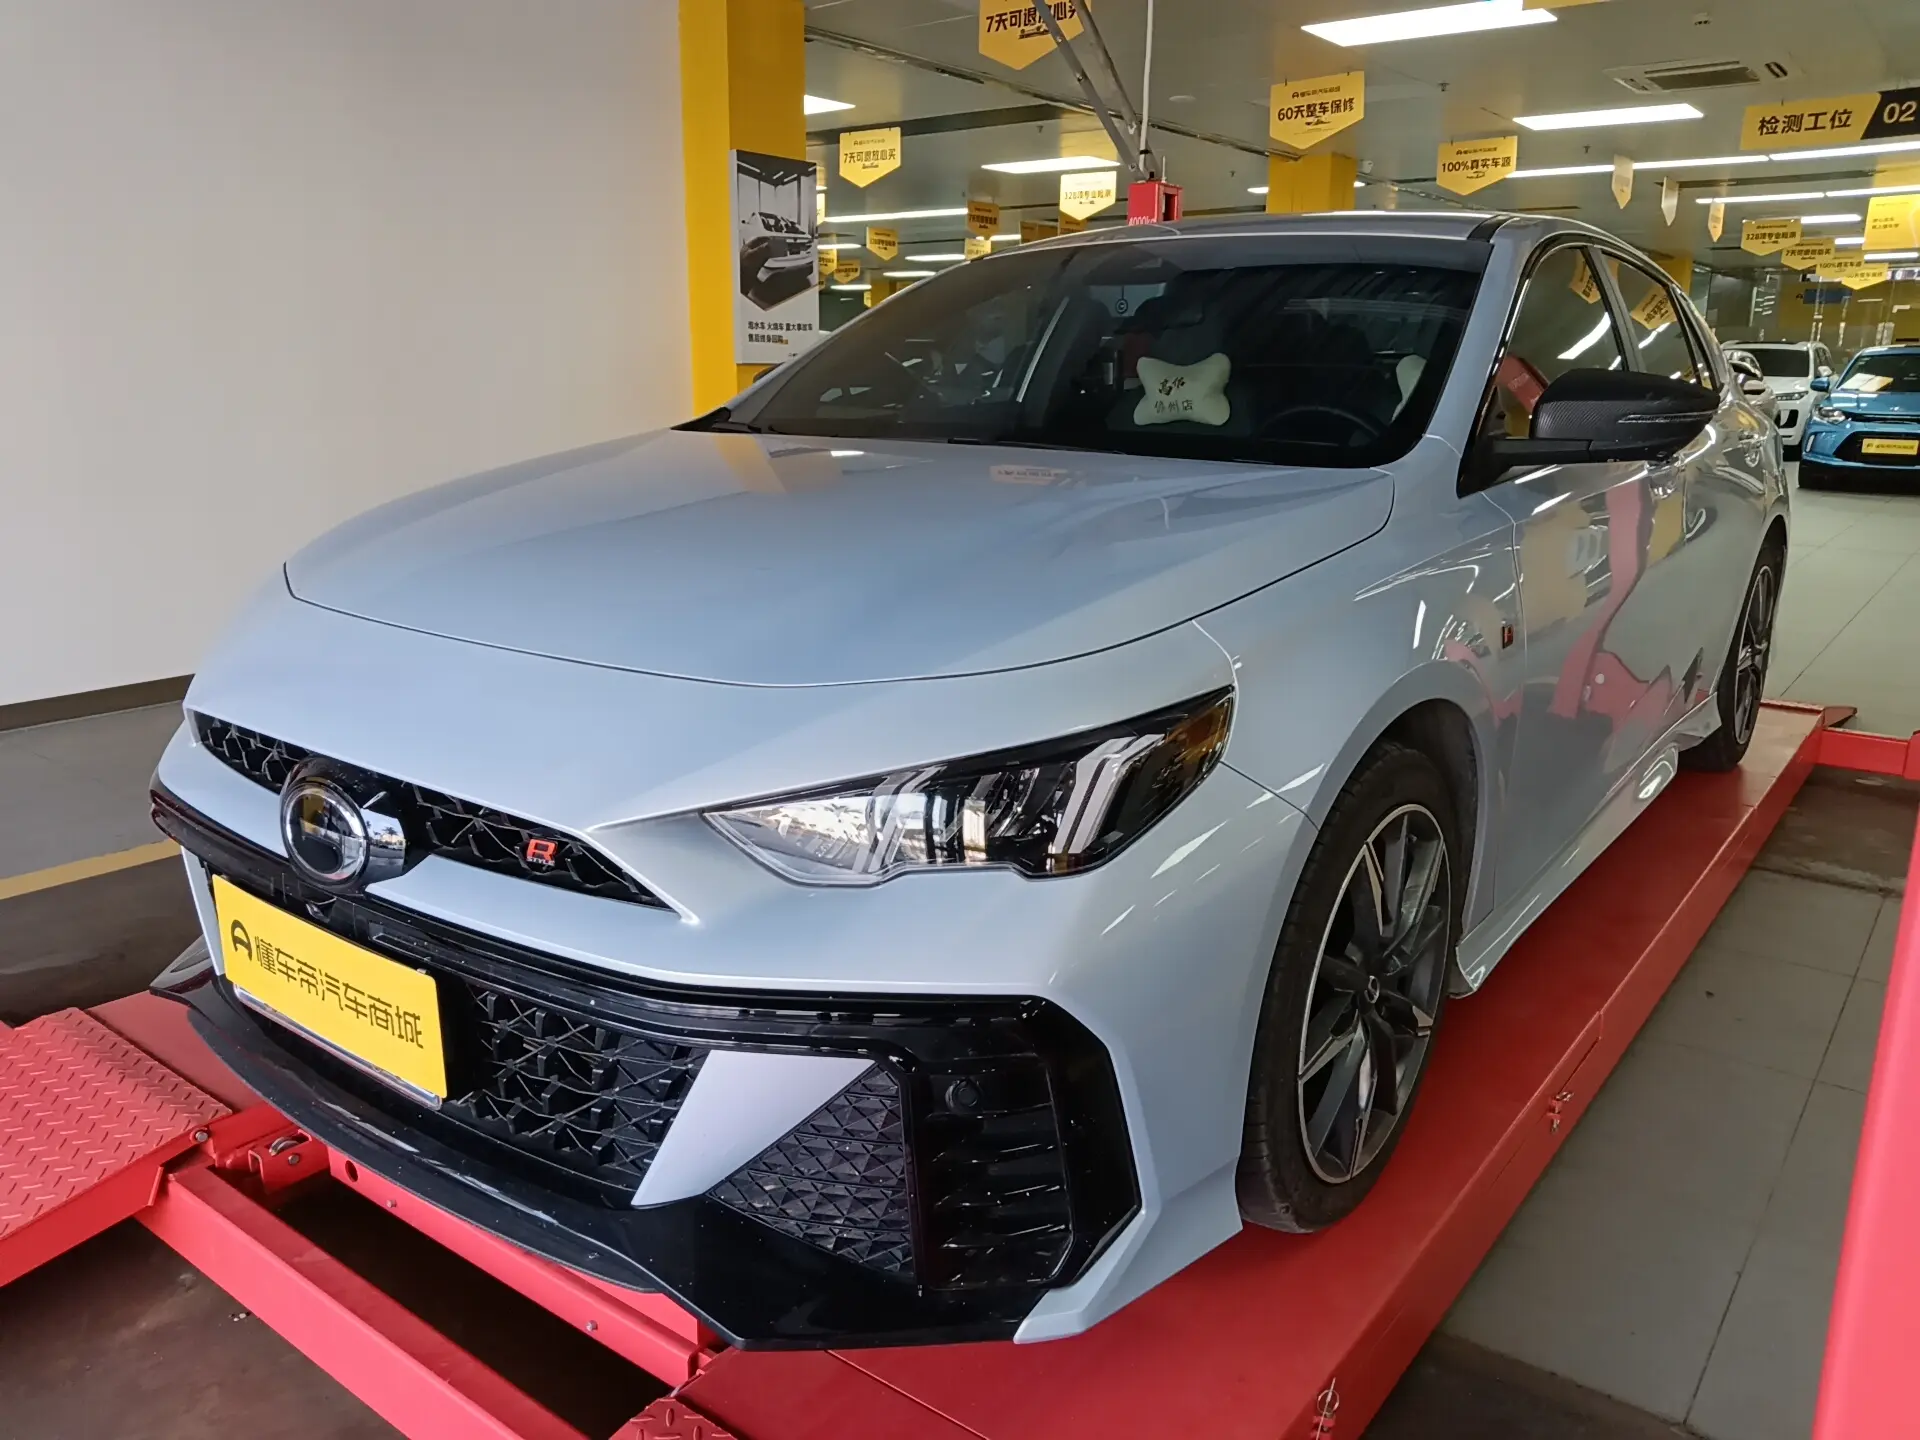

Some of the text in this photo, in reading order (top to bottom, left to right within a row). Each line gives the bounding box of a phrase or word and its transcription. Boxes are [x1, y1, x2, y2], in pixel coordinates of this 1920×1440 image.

[1278, 98, 1355, 121] 60天整车保修
[1758, 101, 1917, 136] 检测工位 02
[844, 149, 896, 163] 7天可退放心买
[1442, 156, 1512, 172] 100%真实车源
[526, 838, 556, 861] R
[254, 936, 424, 1049] 懂车帝汽车商城
